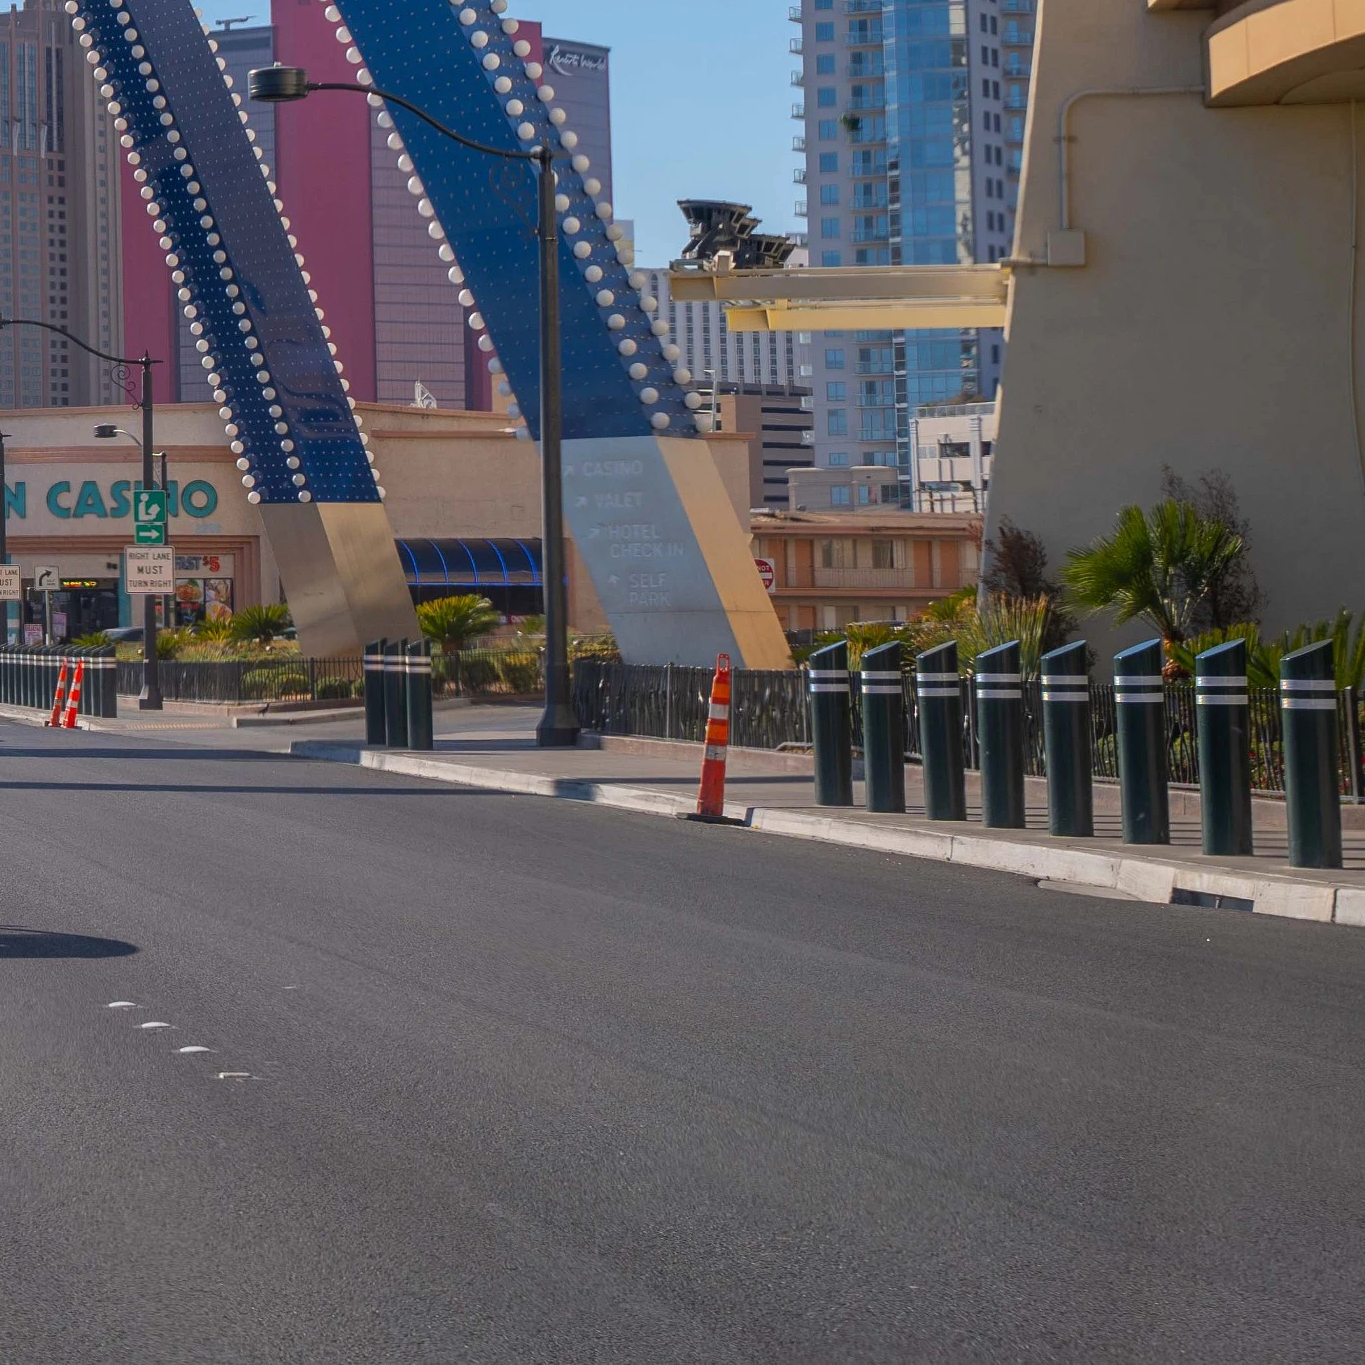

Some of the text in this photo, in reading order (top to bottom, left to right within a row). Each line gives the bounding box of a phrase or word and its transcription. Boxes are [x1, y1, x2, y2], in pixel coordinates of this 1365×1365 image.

[582, 460, 644, 477] CASINO
[46, 479, 218, 518] CASO
[593, 492, 643, 508] VALET
[609, 524, 659, 539] HOTEL
[128, 552, 171, 560] RIGHT LANE
[610, 542, 684, 559] CHECK IN
[137, 566, 163, 574] MUST
[202, 555, 221, 573] $5
[128, 579, 171, 588] TURN RIGHT
[630, 572, 667, 588] SELF
[629, 591, 670, 606] PARK
